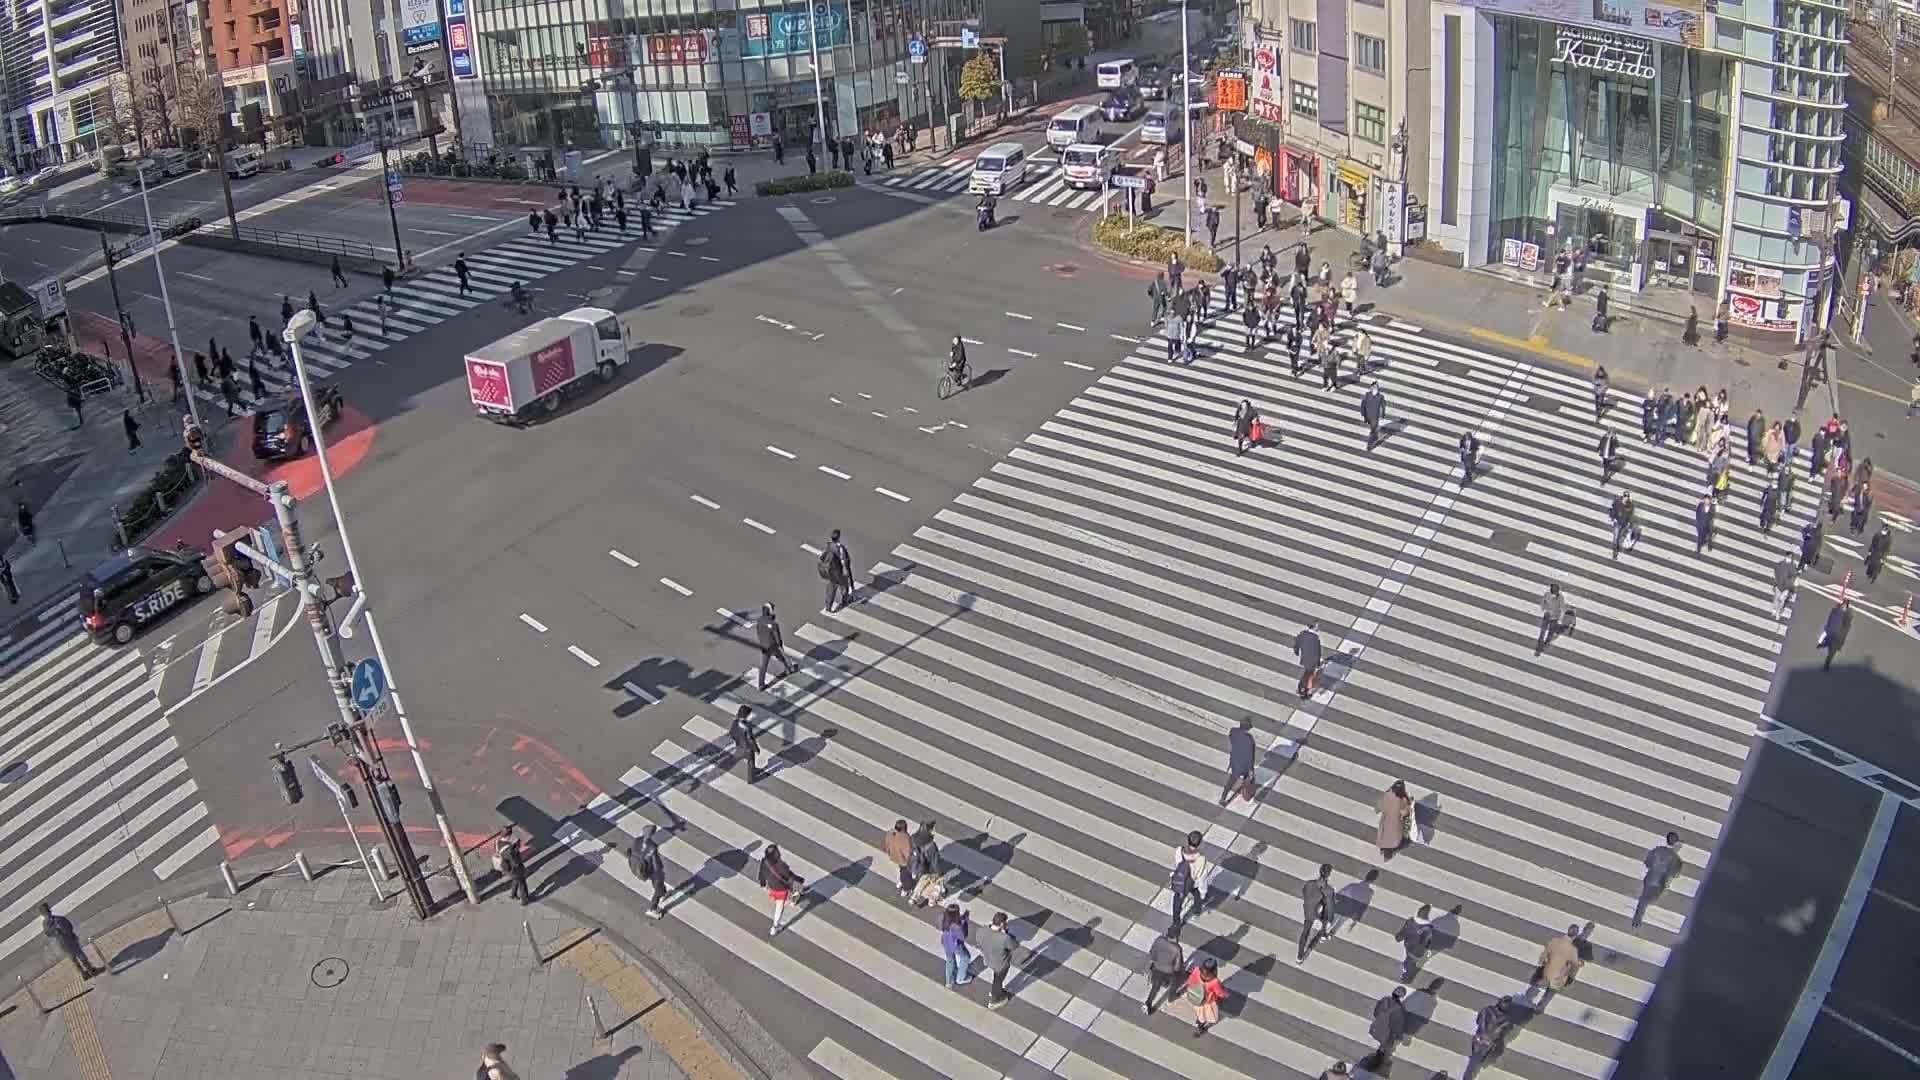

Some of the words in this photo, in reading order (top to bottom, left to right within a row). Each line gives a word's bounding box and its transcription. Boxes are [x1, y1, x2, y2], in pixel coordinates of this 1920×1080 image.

[1556, 25, 1612, 44] PACHINKO
[1624, 38, 1650, 51] SLOT
[1550, 37, 1656, 79] Kaleido
[134, 585, 185, 622] S.RIDE
